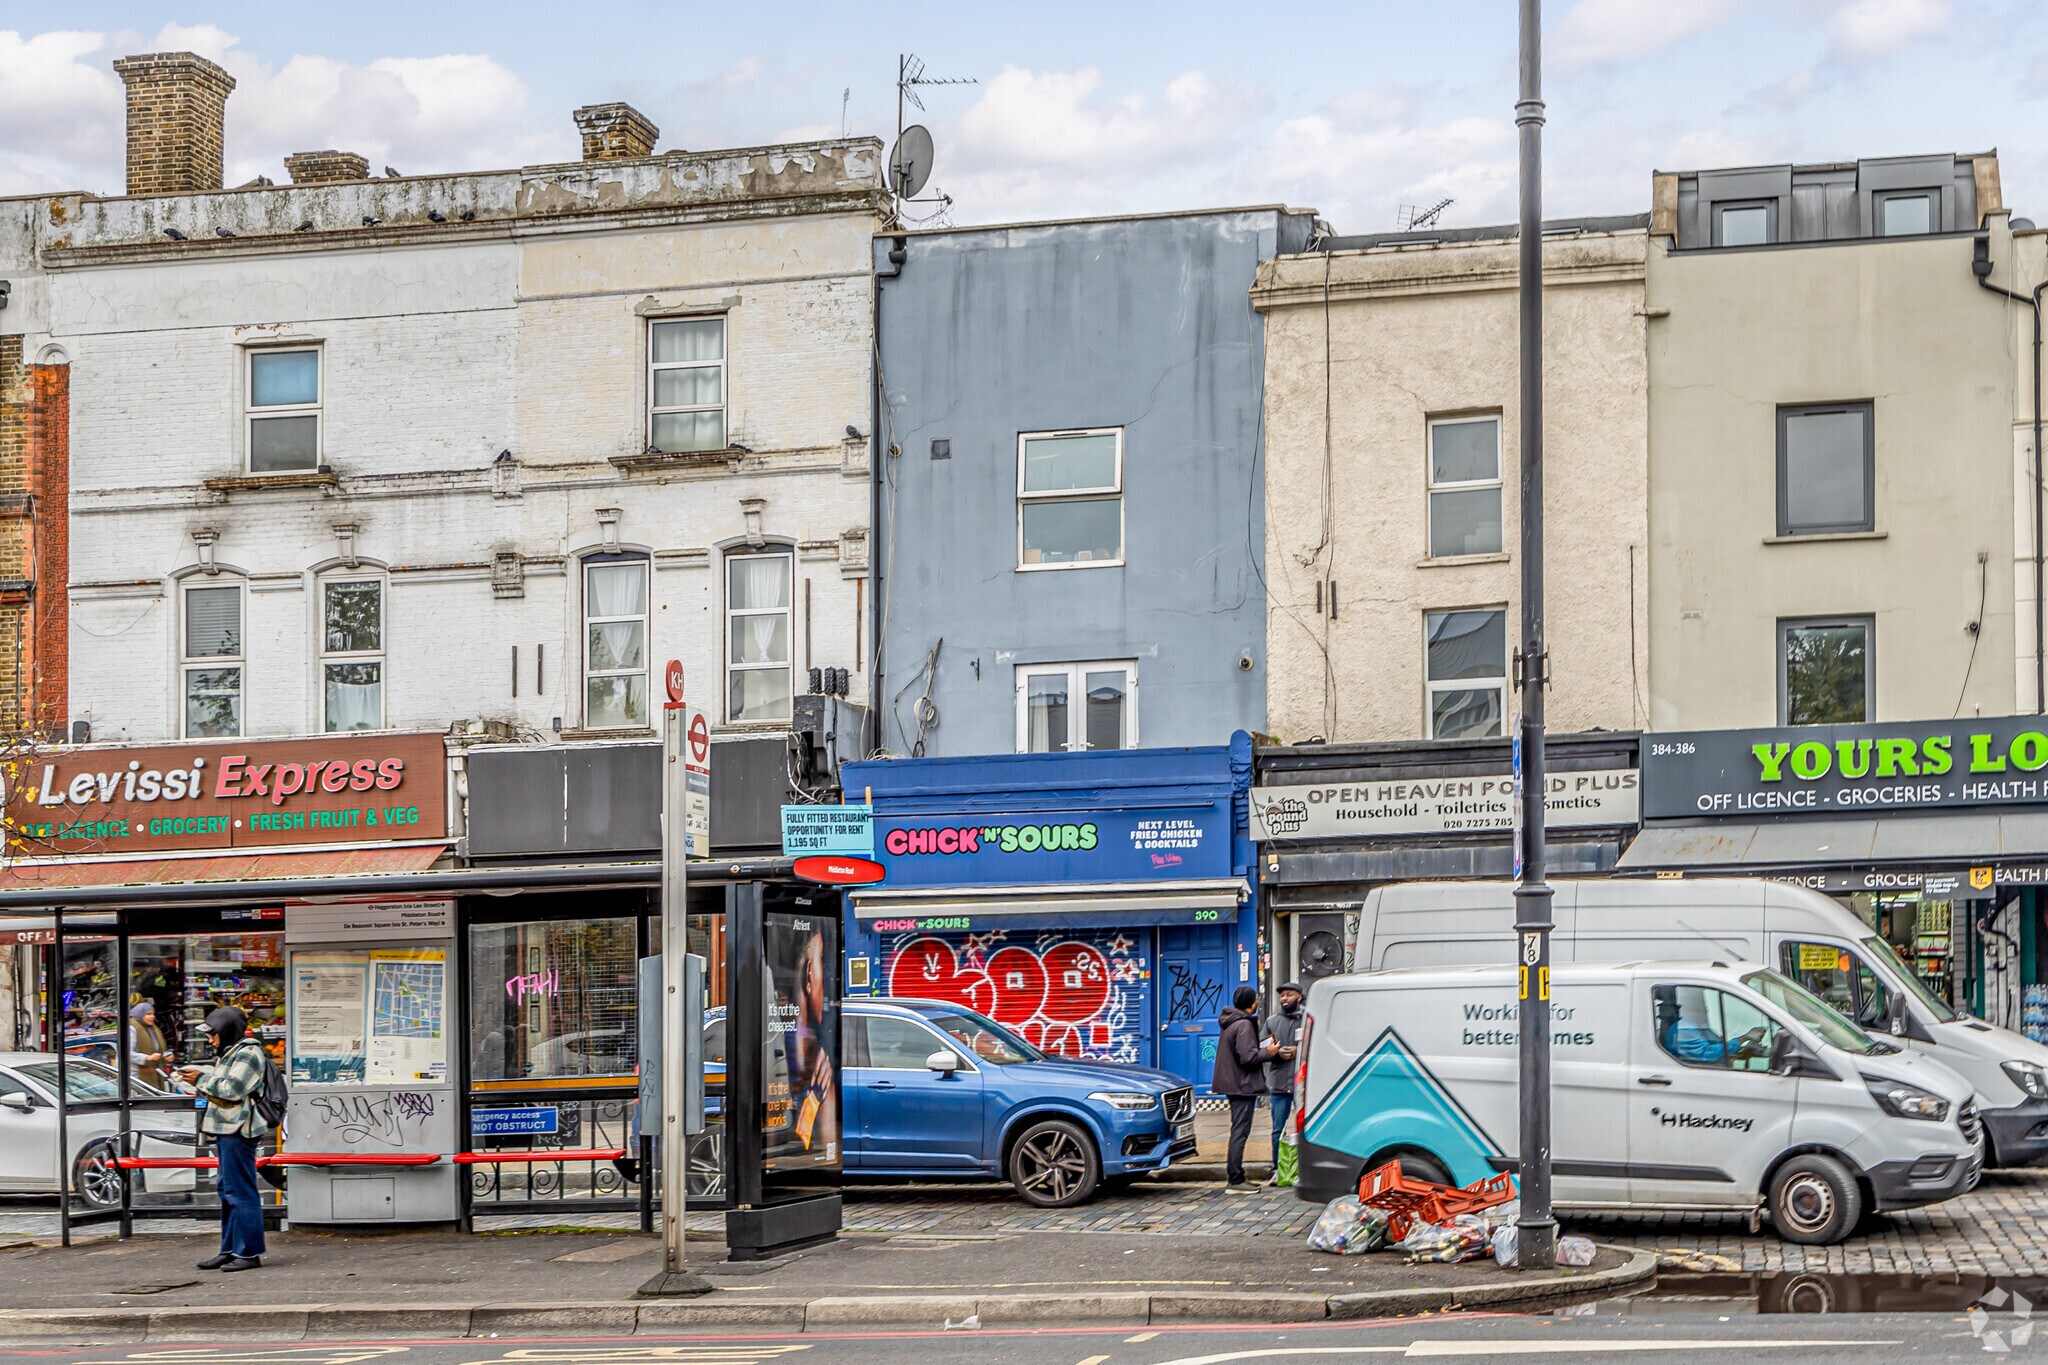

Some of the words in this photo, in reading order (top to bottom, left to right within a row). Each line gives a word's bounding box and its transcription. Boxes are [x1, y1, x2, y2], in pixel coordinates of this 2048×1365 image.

[671, 671, 684, 690] KH
[1651, 743, 1696, 756] 384-386
[1752, 735, 1953, 782] YOURS
[1970, 731, 2048, 773] LO
[38, 757, 205, 806] Levissi
[214, 755, 403, 806] Express
[1307, 786, 1369, 804] OPEN
[1378, 782, 1473, 802] HEAVEN
[1481, 778, 1567, 796] POD
[1575, 773, 1638, 792] PLUS
[1697, 793, 1732, 811] OFF
[1738, 790, 1817, 810] LICENCE
[1837, 785, 1941, 806] GROCERIES
[1962, 781, 2037, 800] HEALTH
[1283, 799, 1305, 811] the
[1336, 803, 1418, 820] Household
[1435, 800, 1507, 816] Toiletries
[1544, 797, 1601, 811] smetics
[60, 819, 130, 839] LICENCE
[150, 815, 229, 836] GROCERY
[250, 812, 305, 831] FRESH
[310, 809, 361, 828] FRUIT
[365, 808, 378, 826] &
[383, 806, 419, 825] VEG
[787, 813, 805, 823] FULLY
[807, 813, 828, 822] FITTED
[830, 813, 869, 822] RESTAURANT
[1267, 808, 1308, 823] pound
[788, 825, 833, 835] OPPORTUNITY
[835, 825, 847, 835] FOR
[849, 825, 864, 834] RENT
[1138, 820, 1163, 830] NEXT
[1166, 820, 1195, 829] LEVEL
[1271, 820, 1301, 835] plus
[1443, 820, 1463, 829] 020
[1494, 817, 1513, 827] 785
[885, 827, 979, 856] CHICK
[1000, 822, 1098, 853] SOURS
[1130, 830, 1158, 840] FRIED
[1160, 829, 1203, 839] CHICKEN
[809, 837, 819, 848] SQ
[820, 837, 827, 846] FT
[1134, 840, 1143, 849] &
[1144, 839, 1198, 849] COCKTAILS
[1863, 873, 1923, 887] GROCER
[1995, 867, 2040, 883] EALTH
[1195, 910, 1217, 920] 390
[872, 919, 917, 931] CHICK
[926, 917, 970, 929] SOURS
[17, 931, 42, 942] OFF
[779, 1003, 788, 1016] not
[789, 1002, 800, 1016] the
[1463, 1003, 1519, 1021] Worki
[1551, 1003, 1576, 1021] for
[1462, 1028, 1519, 1045] better
[1553, 1032, 1595, 1045] mes
[472, 1112, 509, 1121] ergency
[512, 1111, 540, 1120] access
[1679, 1113, 1755, 1133] Hackney
[473, 1123, 493, 1131] NOT
[495, 1121, 546, 1130] OBSTRUCT
